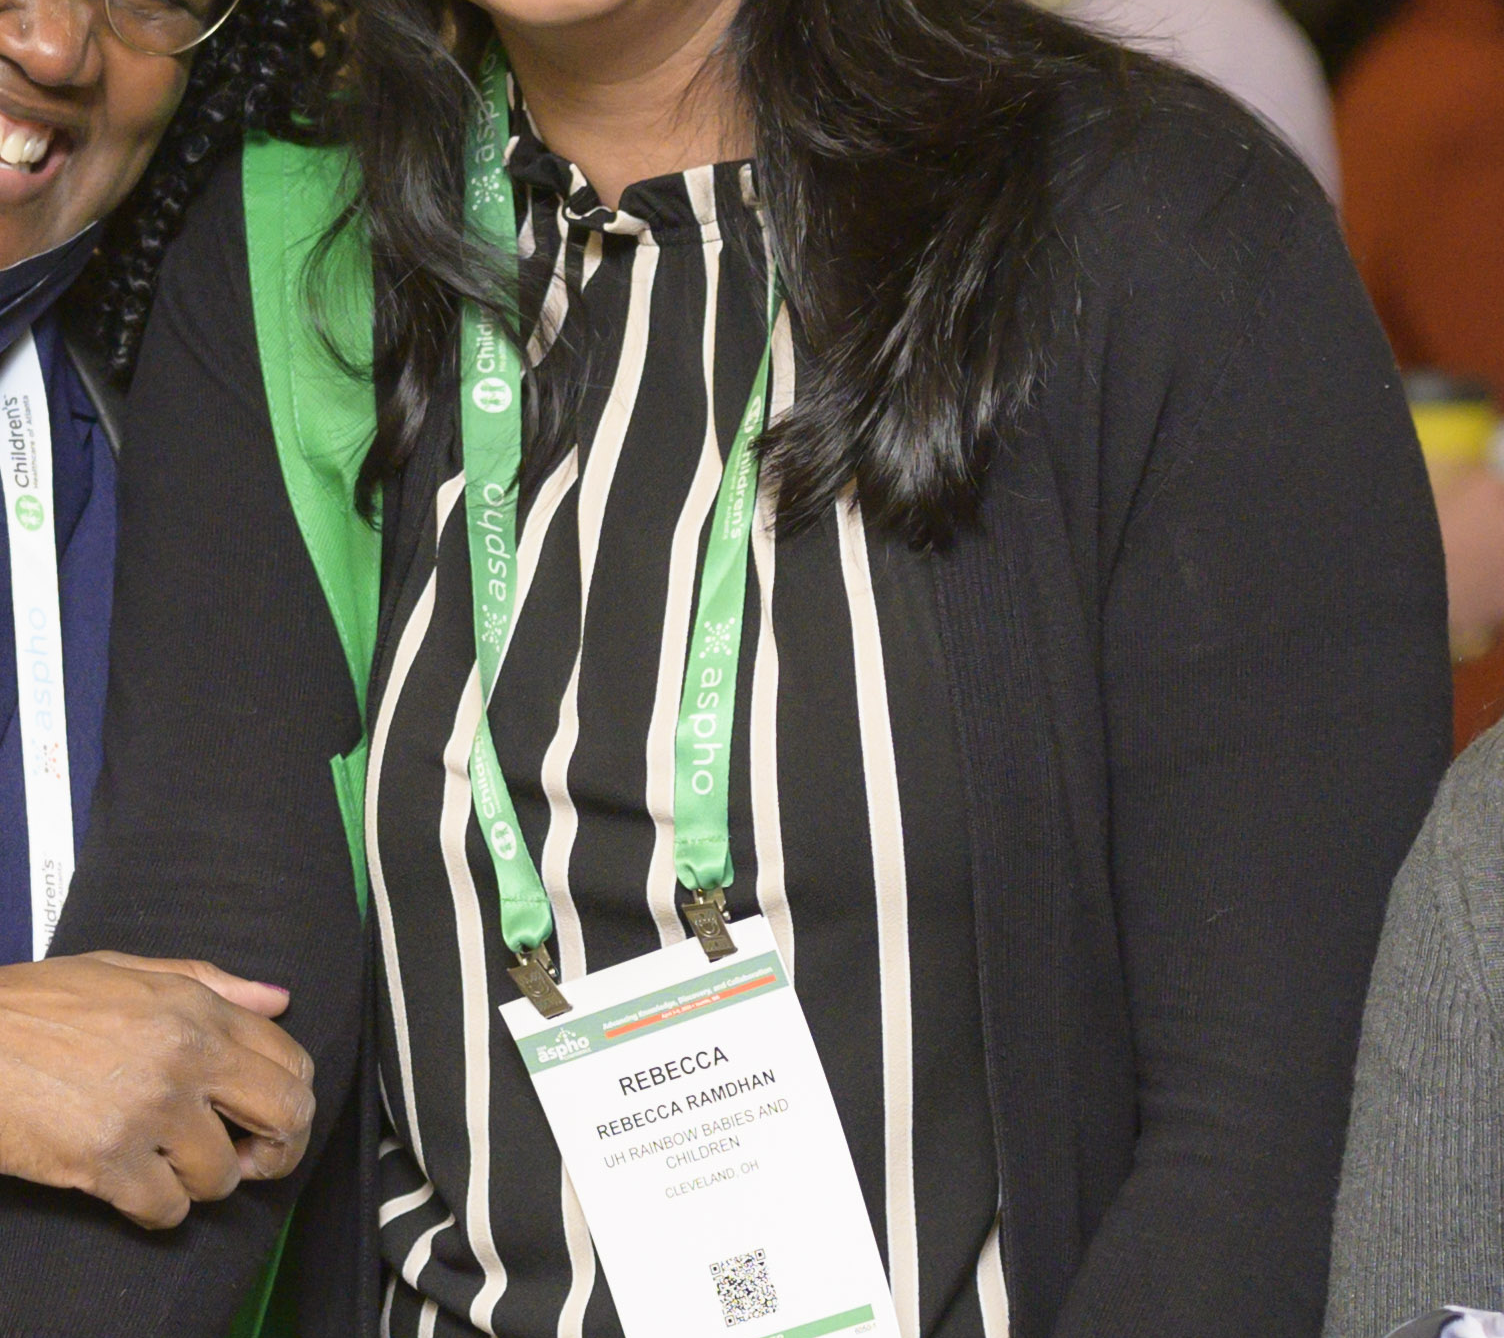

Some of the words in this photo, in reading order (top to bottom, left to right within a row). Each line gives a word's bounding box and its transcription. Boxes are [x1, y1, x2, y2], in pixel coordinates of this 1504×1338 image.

[1, 394, 30, 489] Children's
[476, 482, 512, 602] aspho
[23, 606, 54, 732] aspho
[688, 666, 724, 797] aspho
[537, 1034, 590, 1064] aspho
[618, 1046, 730, 1096] REBECCA
[596, 1101, 683, 1140] REBECCA
[685, 1069, 777, 1111] RAMDHAN
[604, 1151, 627, 1169] UH
[628, 1127, 698, 1161] RAINBOW
[701, 1109, 755, 1138] BABIES
[759, 1098, 790, 1119] AND
[665, 1135, 741, 1170] CHILDREN
[665, 1168, 740, 1199] CLEVELAND,
[740, 1159, 760, 1176] OH
